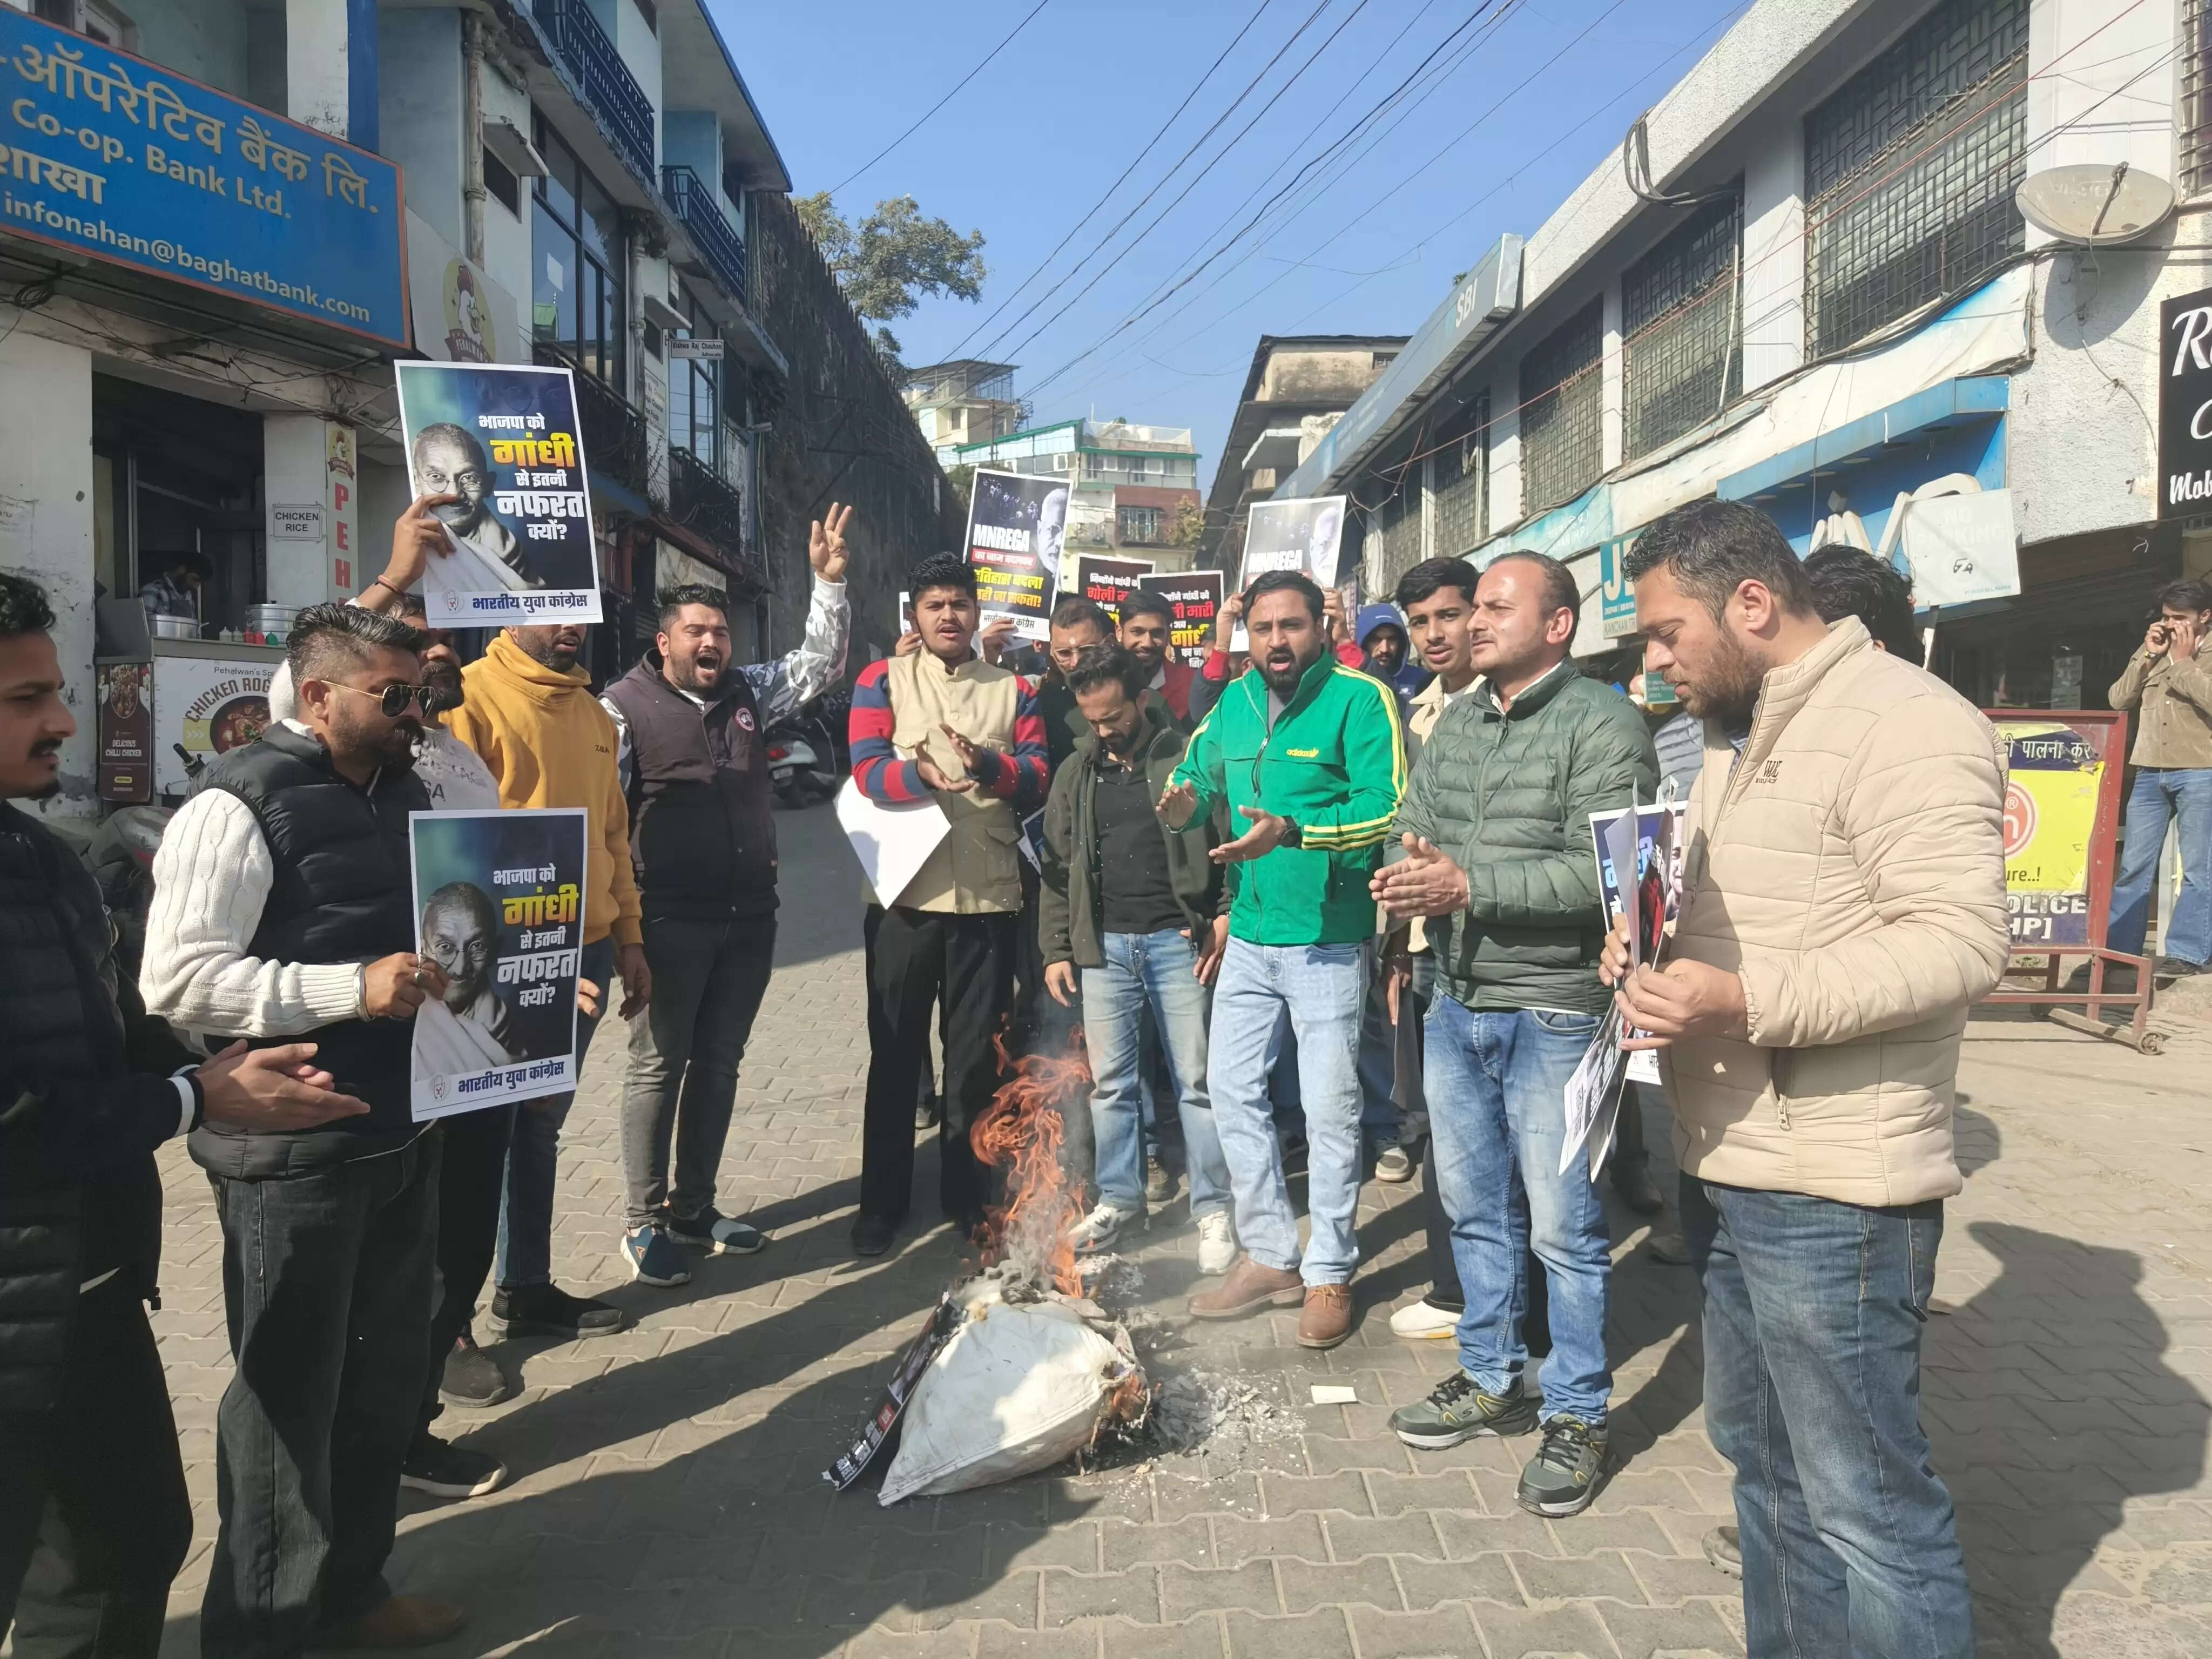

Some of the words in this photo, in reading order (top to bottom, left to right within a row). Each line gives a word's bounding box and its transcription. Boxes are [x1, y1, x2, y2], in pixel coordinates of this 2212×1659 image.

[12, 98, 134, 164] Co-op.
[147, 144, 226, 196] Bank
[237, 177, 292, 219] Ltd.
[236, 115, 311, 182] बैंक
[321, 153, 378, 213] लि.
[5, 192, 370, 322] infonahan@baghatbank.com
[1455, 277, 1478, 328] SBI
[478, 414, 524, 430] भाजपा
[527, 413, 545, 430] को
[489, 432, 576, 467] गांधी
[515, 468, 530, 487] से
[532, 468, 567, 487] इतनी
[494, 490, 585, 518] नफरत
[275, 512, 319, 521] CHICKEN
[285, 523, 309, 532] RICE
[527, 520, 567, 541] क्यों?
[973, 523, 1030, 552] MNREGA
[1247, 549, 1303, 573] MNREGA
[1013, 574, 1044, 589] बदला
[473, 594, 520, 610] भारतीय
[522, 595, 546, 614] युवा
[549, 592, 588, 609] कांग्रेस
[1087, 585, 1115, 601] गोली
[1187, 600, 1214, 617] मारी
[1016, 617, 1035, 629] कांग्रेस
[214, 666, 260, 676] Pehalwan's
[185, 679, 239, 723] CHICKEN
[112, 739, 136, 747] DELICIOUS
[2022, 740, 2065, 759] पालना
[494, 867, 537, 886] भाजपा
[539, 863, 556, 884] को
[502, 883, 579, 927] गांधी
[520, 933, 534, 949] से
[535, 927, 567, 948] इतनी
[497, 948, 578, 985] नफरत
[520, 983, 556, 1008] क्यों?
[458, 1069, 504, 1094] भारतीय
[506, 1065, 527, 1089] युवा
[529, 1060, 565, 1079] कांग्रेस
